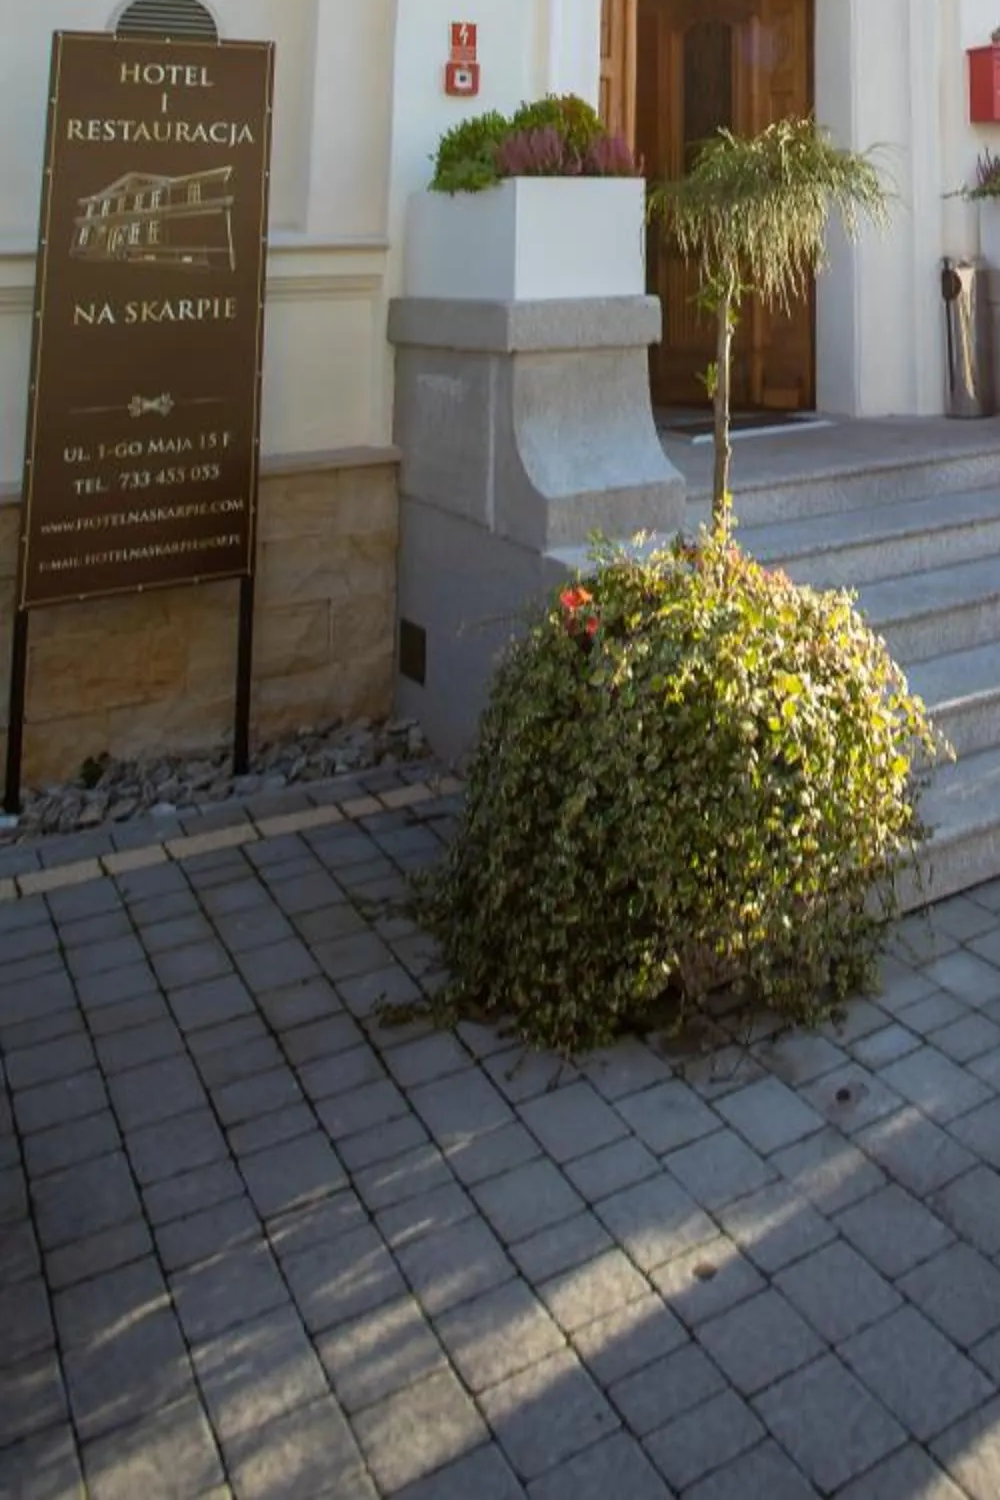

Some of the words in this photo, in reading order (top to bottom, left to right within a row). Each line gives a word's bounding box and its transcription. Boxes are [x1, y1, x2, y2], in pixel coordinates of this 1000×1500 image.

[120, 63, 213, 87] HOTEL
[161, 93, 168, 113] I
[67, 119, 255, 147] RESTAURACJA
[73, 303, 116, 325] NA
[125, 298, 236, 324] SKARPIE
[147, 436, 193, 455] MAJA
